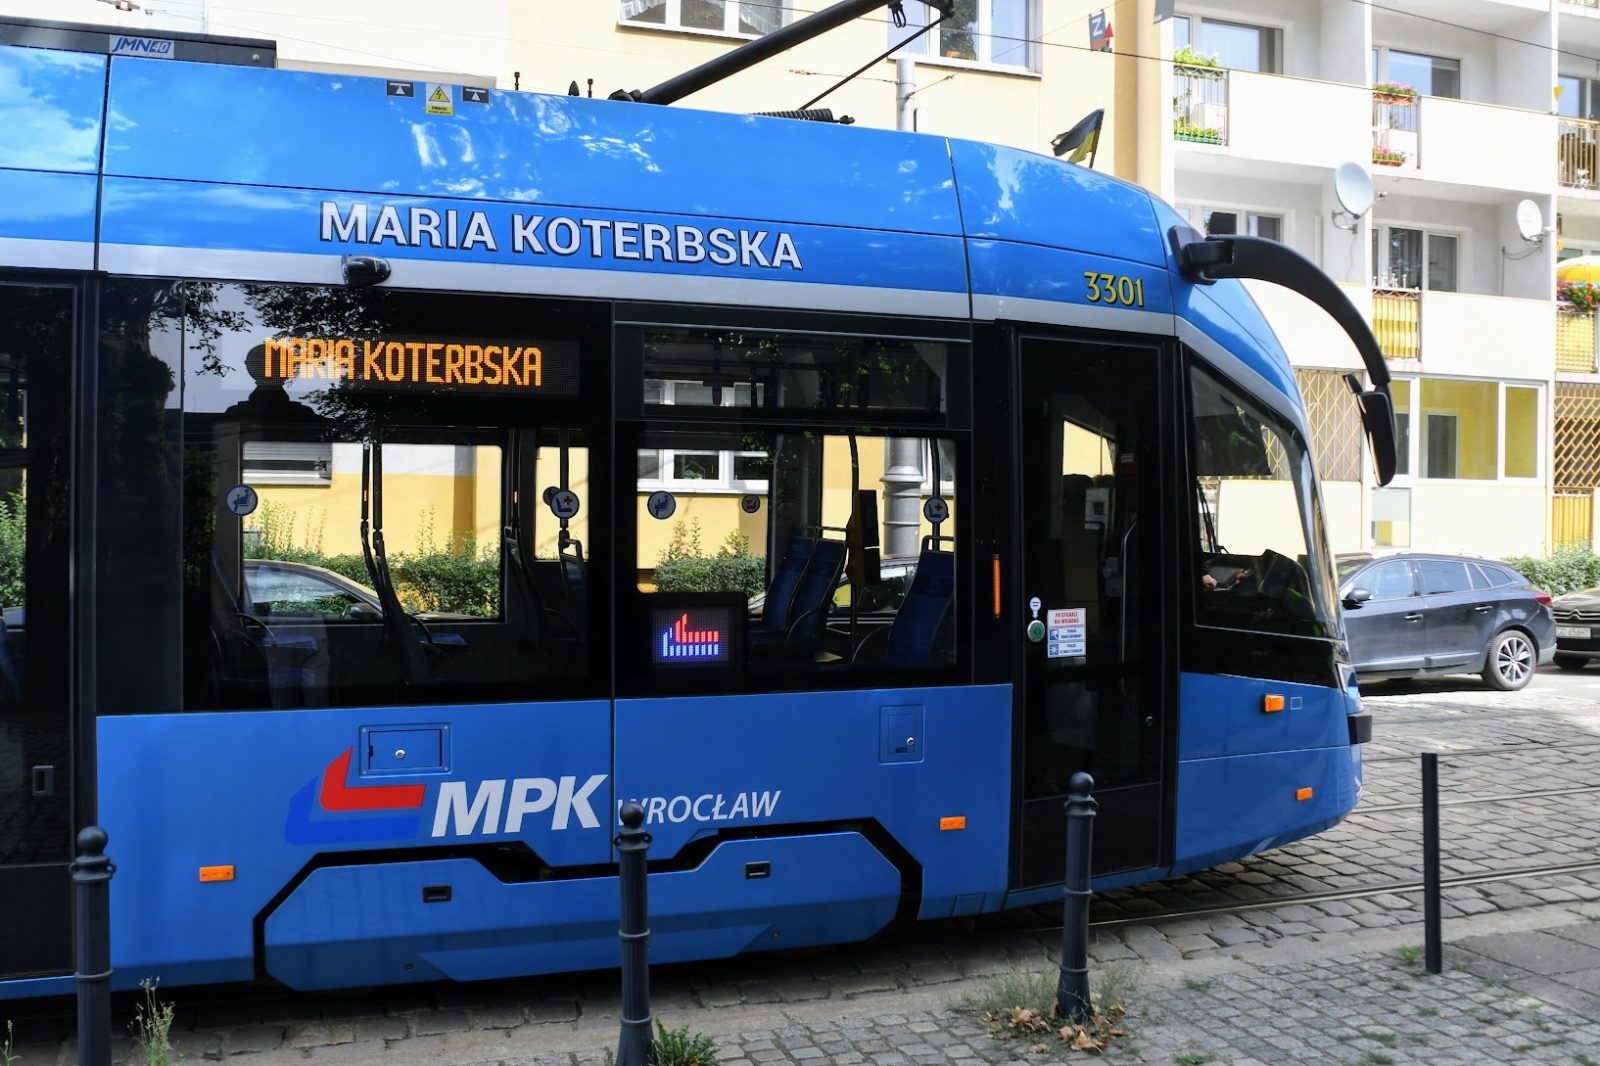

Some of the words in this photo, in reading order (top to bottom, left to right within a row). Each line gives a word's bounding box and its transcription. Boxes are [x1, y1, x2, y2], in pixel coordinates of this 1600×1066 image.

[320, 200, 498, 252] MARIA
[512, 213, 803, 271] KOTERBSKA
[1083, 271, 1144, 307] 3301
[264, 336, 355, 380] MARIA
[363, 340, 542, 387] KOTERBSKA
[431, 774, 608, 838] MPK
